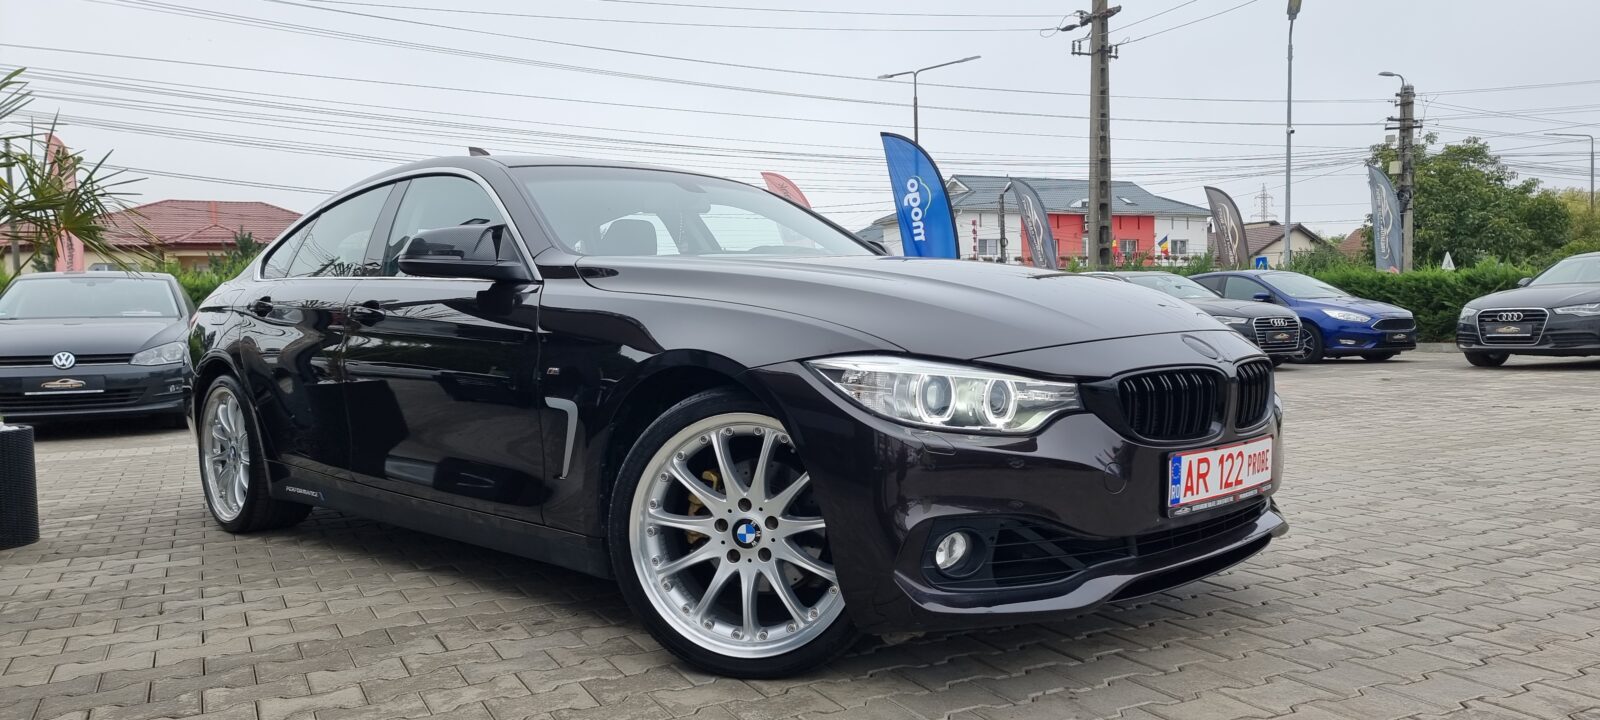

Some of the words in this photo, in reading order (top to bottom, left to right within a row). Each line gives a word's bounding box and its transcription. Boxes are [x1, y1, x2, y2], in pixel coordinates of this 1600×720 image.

[1183, 457, 1210, 498] AR
[1218, 451, 1244, 490] 122
[1247, 449, 1270, 476] PROBE
[1171, 484, 1180, 500] RO
